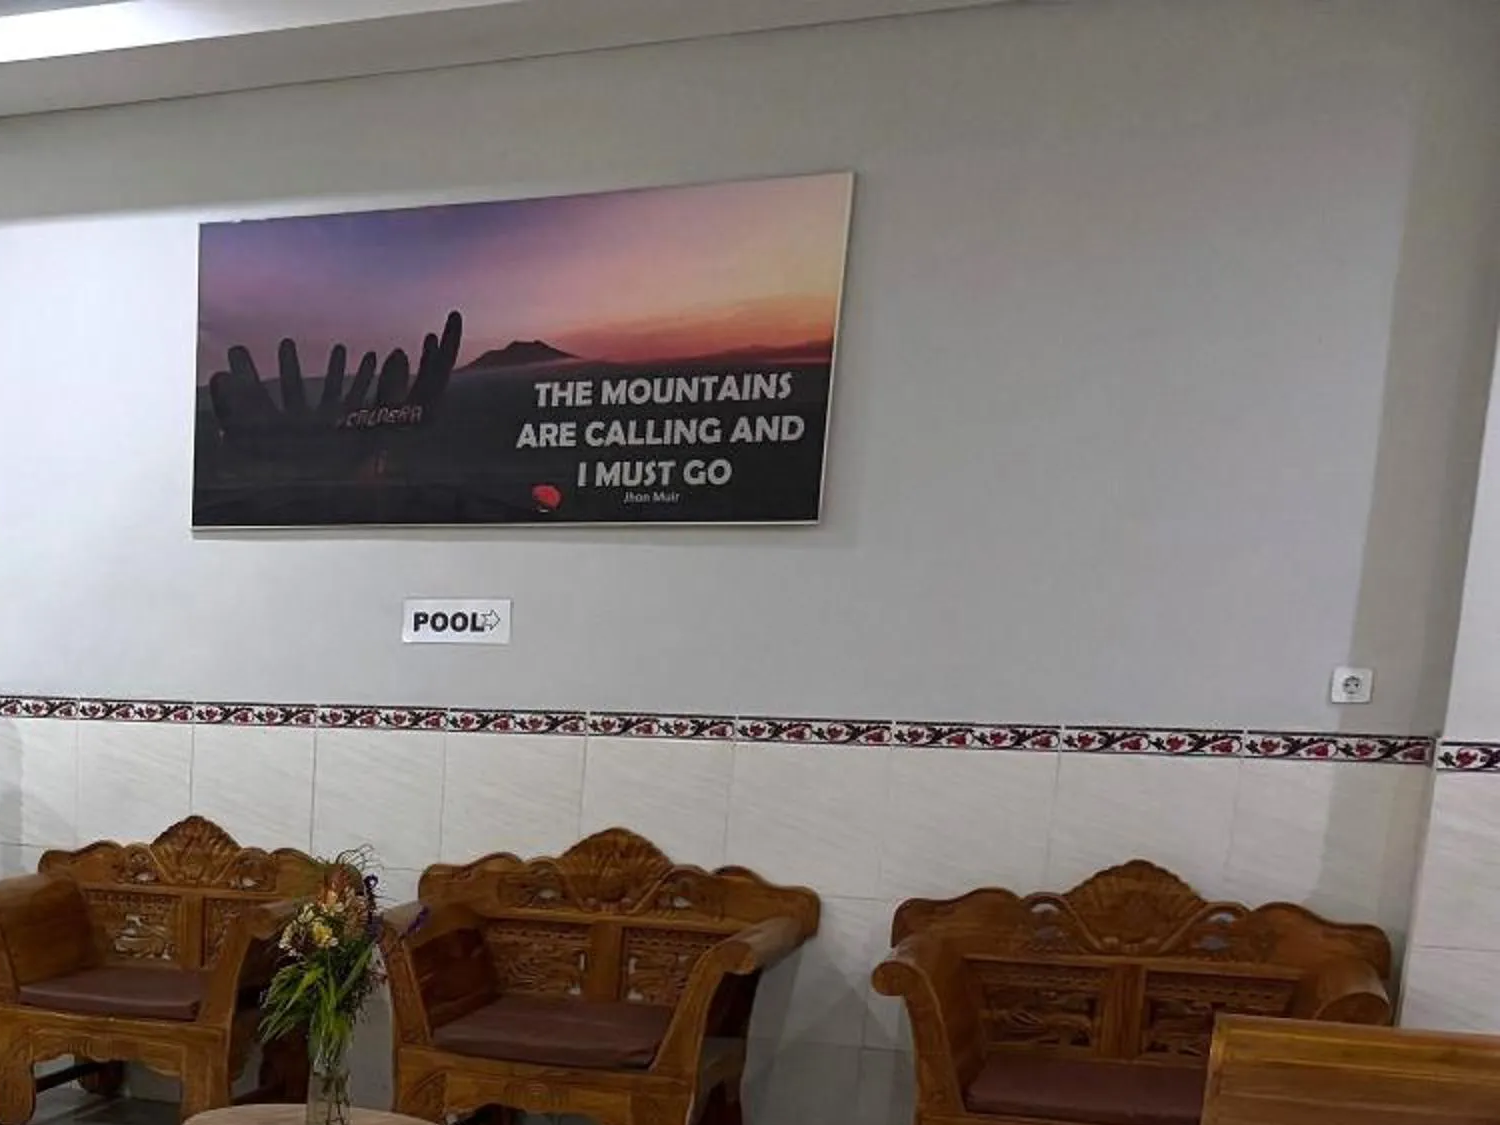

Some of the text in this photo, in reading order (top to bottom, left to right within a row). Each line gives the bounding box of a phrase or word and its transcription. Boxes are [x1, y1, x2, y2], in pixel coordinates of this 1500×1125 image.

[534, 371, 793, 407] THE MOUNTAINS
[516, 415, 806, 448] ARE CALLING AND
[578, 458, 733, 487] I MUST GO
[414, 612, 485, 632] POOL
